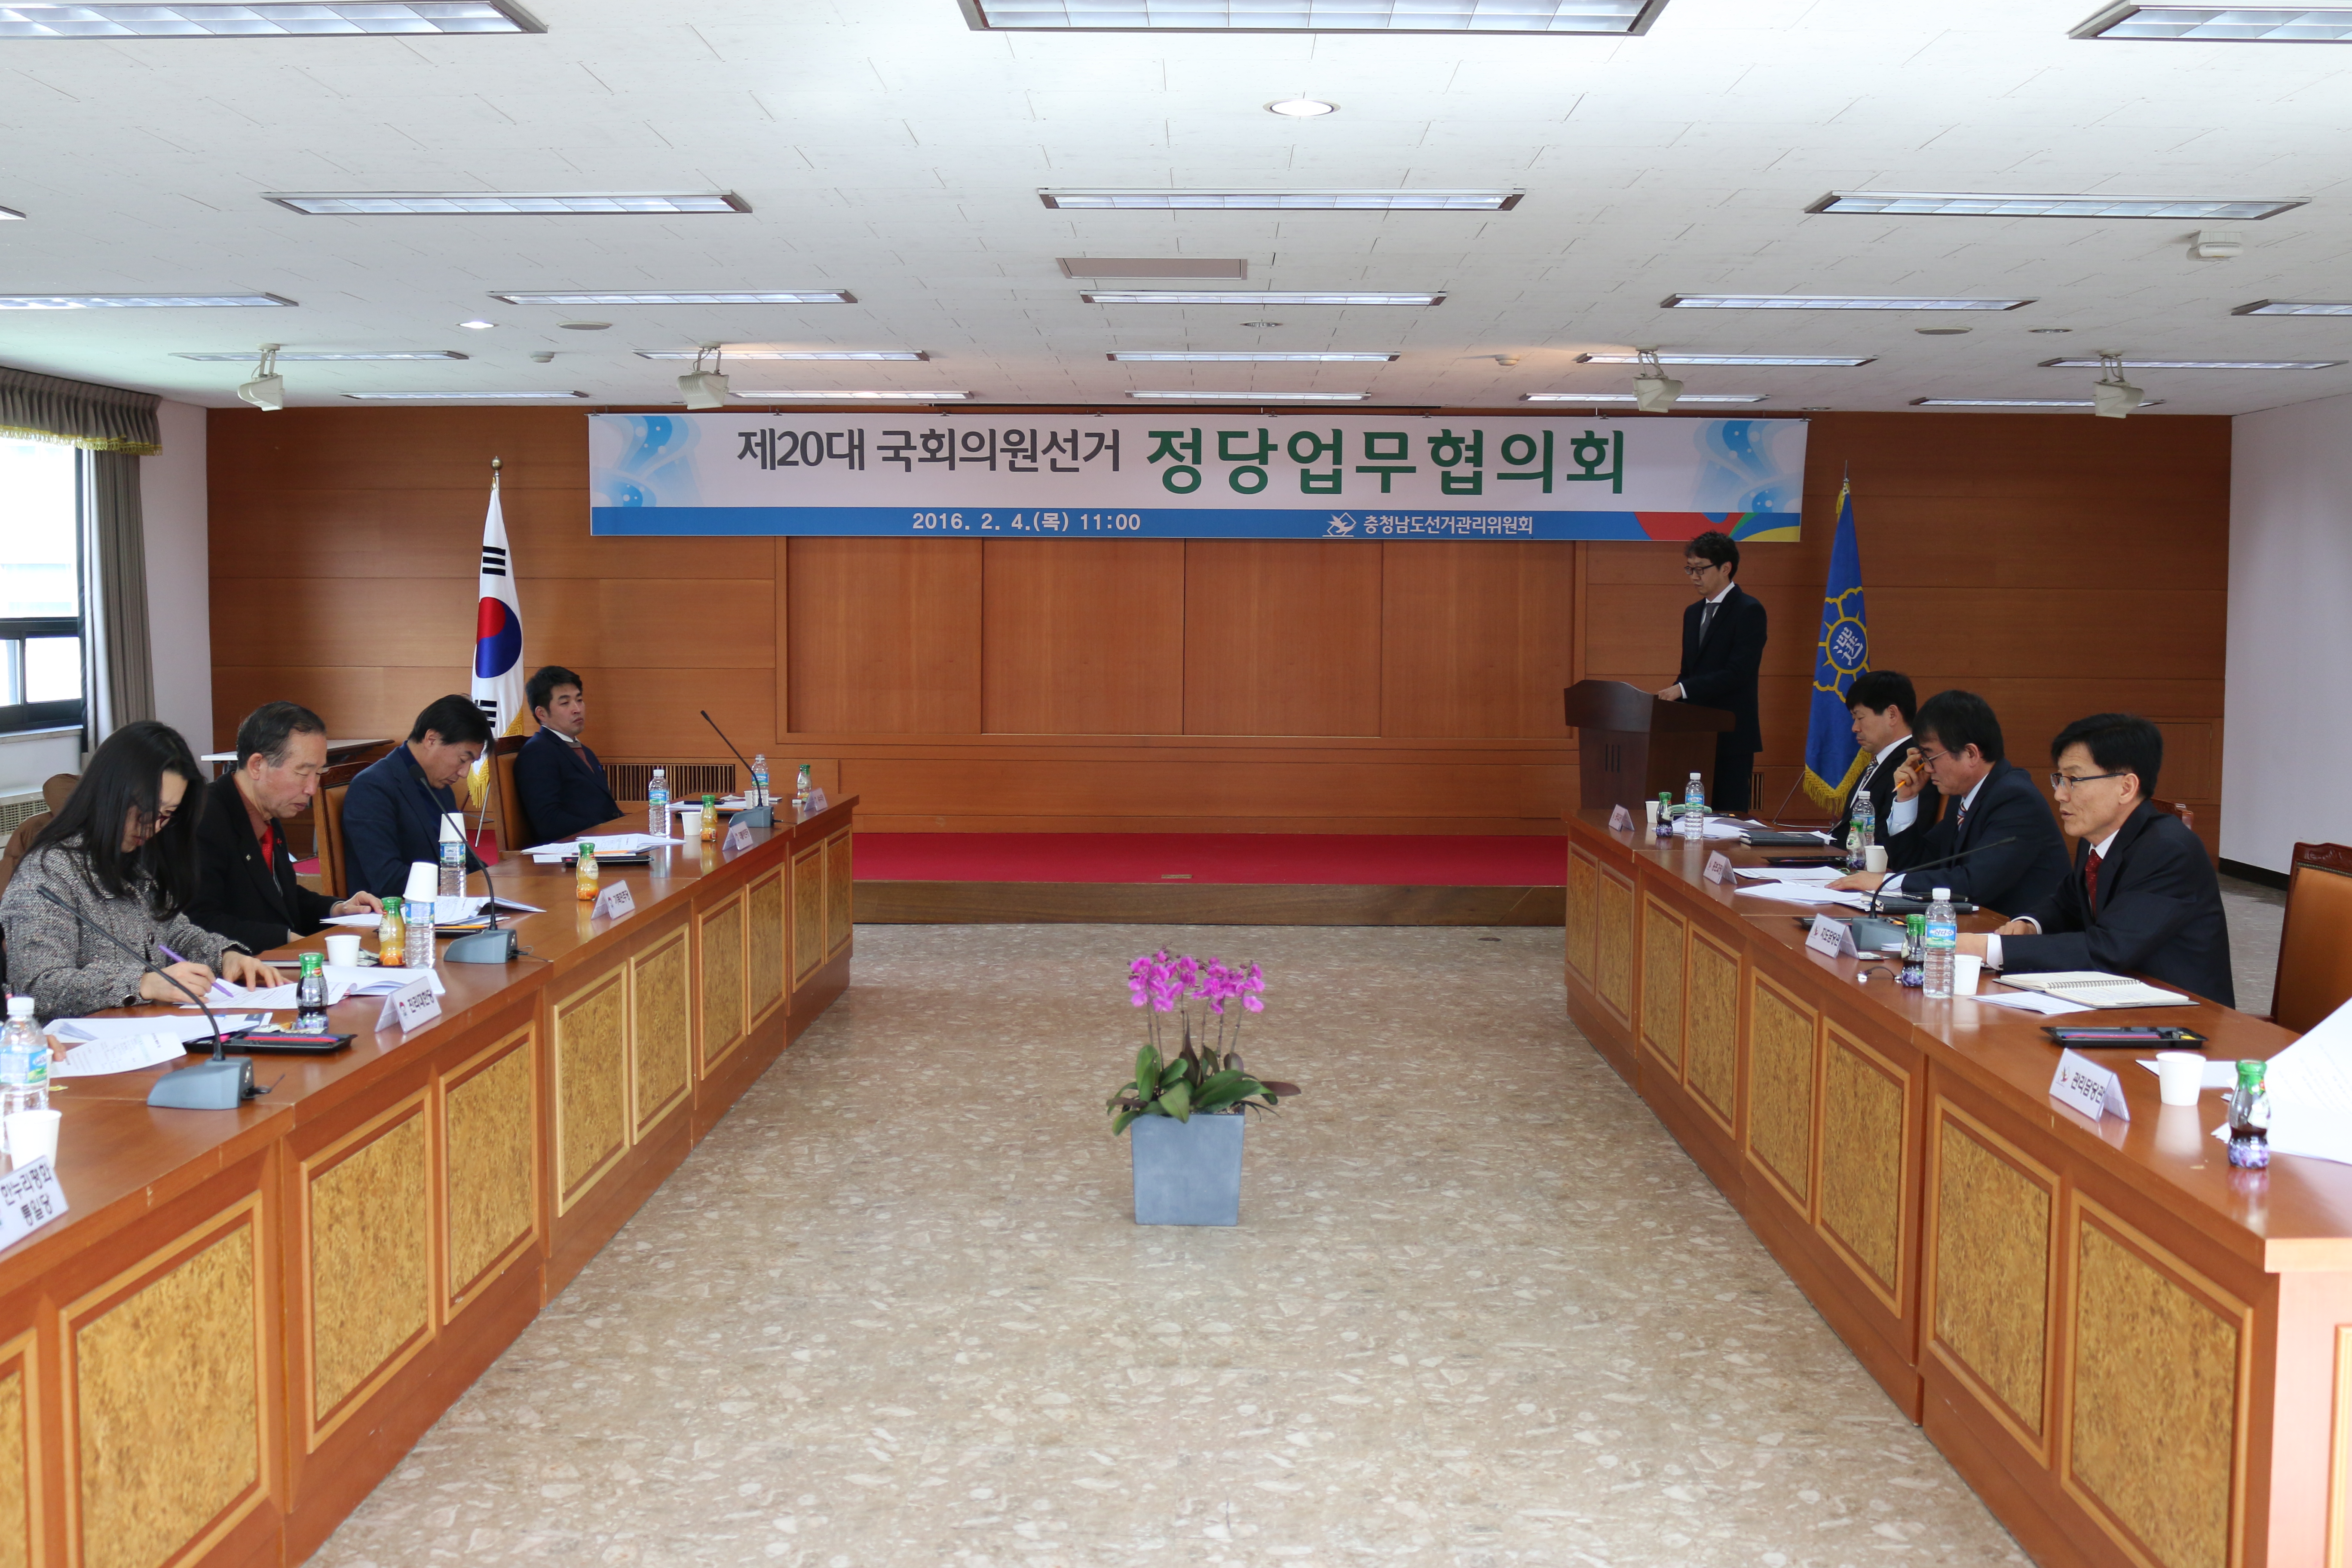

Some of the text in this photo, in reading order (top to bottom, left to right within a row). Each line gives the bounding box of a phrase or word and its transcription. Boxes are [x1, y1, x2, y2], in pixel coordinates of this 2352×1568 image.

[737, 427, 1624, 496] 제20대 국회의원선거 정당업무협의회
[913, 511, 1140, 532] 2016. 2. 4.(목) 11:00
[1363, 515, 1533, 534] 충청남도선거관리위원회
[1820, 928, 1841, 946] 지도담당관
[407, 989, 434, 1014] 진리대한당
[2070, 1072, 2106, 1104] 관리담당관
[0, 1163, 52, 1206] 한누리평화
[21, 1193, 52, 1226] 통일당
